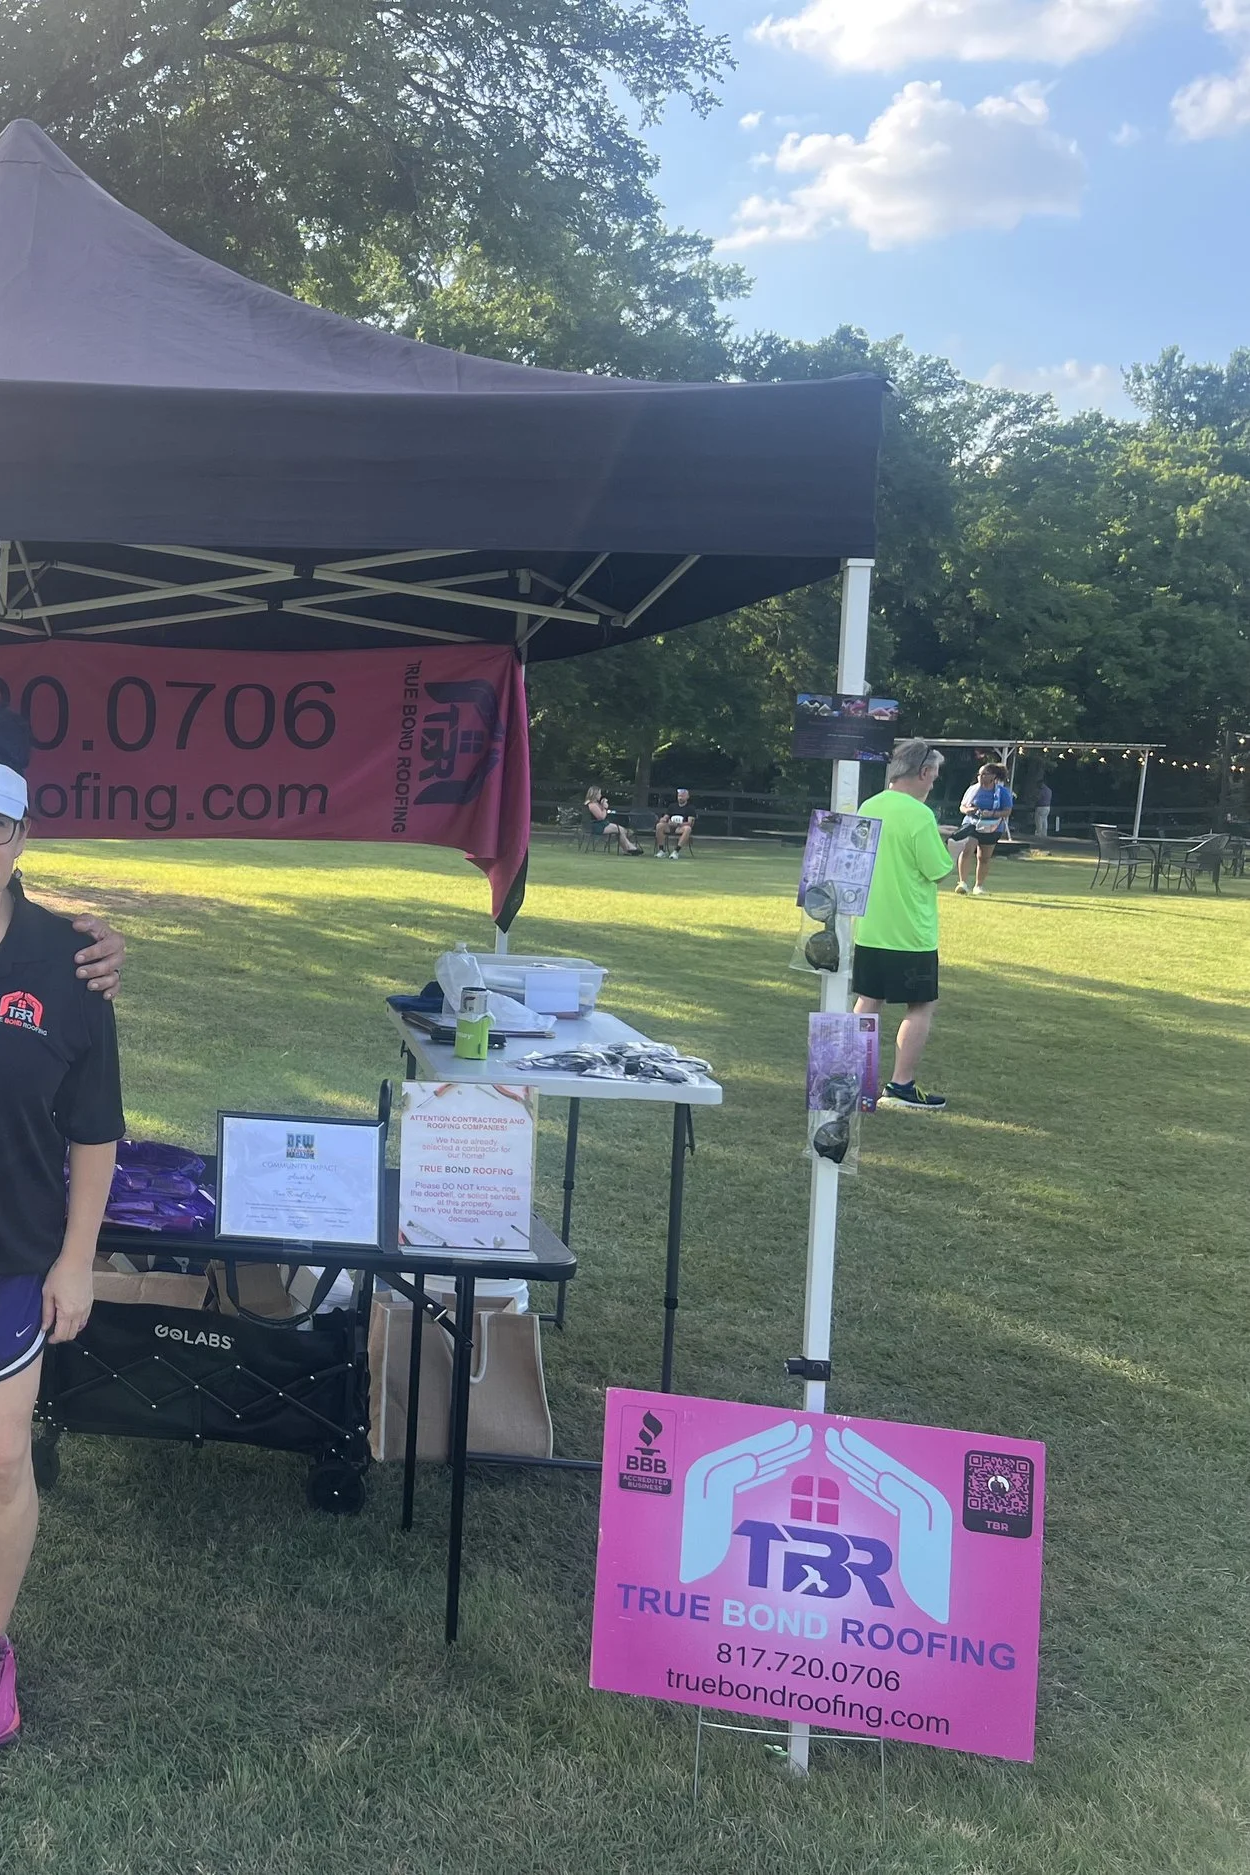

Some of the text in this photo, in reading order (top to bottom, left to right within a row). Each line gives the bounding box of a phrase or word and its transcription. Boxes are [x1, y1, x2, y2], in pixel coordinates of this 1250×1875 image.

[391, 660, 422, 833] TRUE BOND ROOFING
[418, 702, 459, 782] TBR
[9, 1005, 33, 1023] TBR
[427, 1122, 461, 1130] ROOFING
[451, 1116, 508, 1124] CONTRACTORS
[450, 1137, 469, 1145] have
[419, 1165, 514, 1176] TRUE BOND ROOFING
[415, 1181, 441, 1190] Please
[456, 1183, 474, 1191] NOT
[413, 1205, 436, 1213] Thank
[437, 1207, 450, 1215] you
[452, 1206, 463, 1214] for
[626, 1454, 667, 1474] BBB
[622, 1474, 669, 1486] ACCREDITED
[627, 1481, 663, 1492] BUSINESS
[985, 1520, 1009, 1532] TBR
[733, 1519, 895, 1609] TBR
[617, 1583, 1016, 1672] TRUE BOND ROOFING
[716, 1642, 901, 1692] 817.720.0706
[666, 1667, 950, 1736] truebondroofing.com
